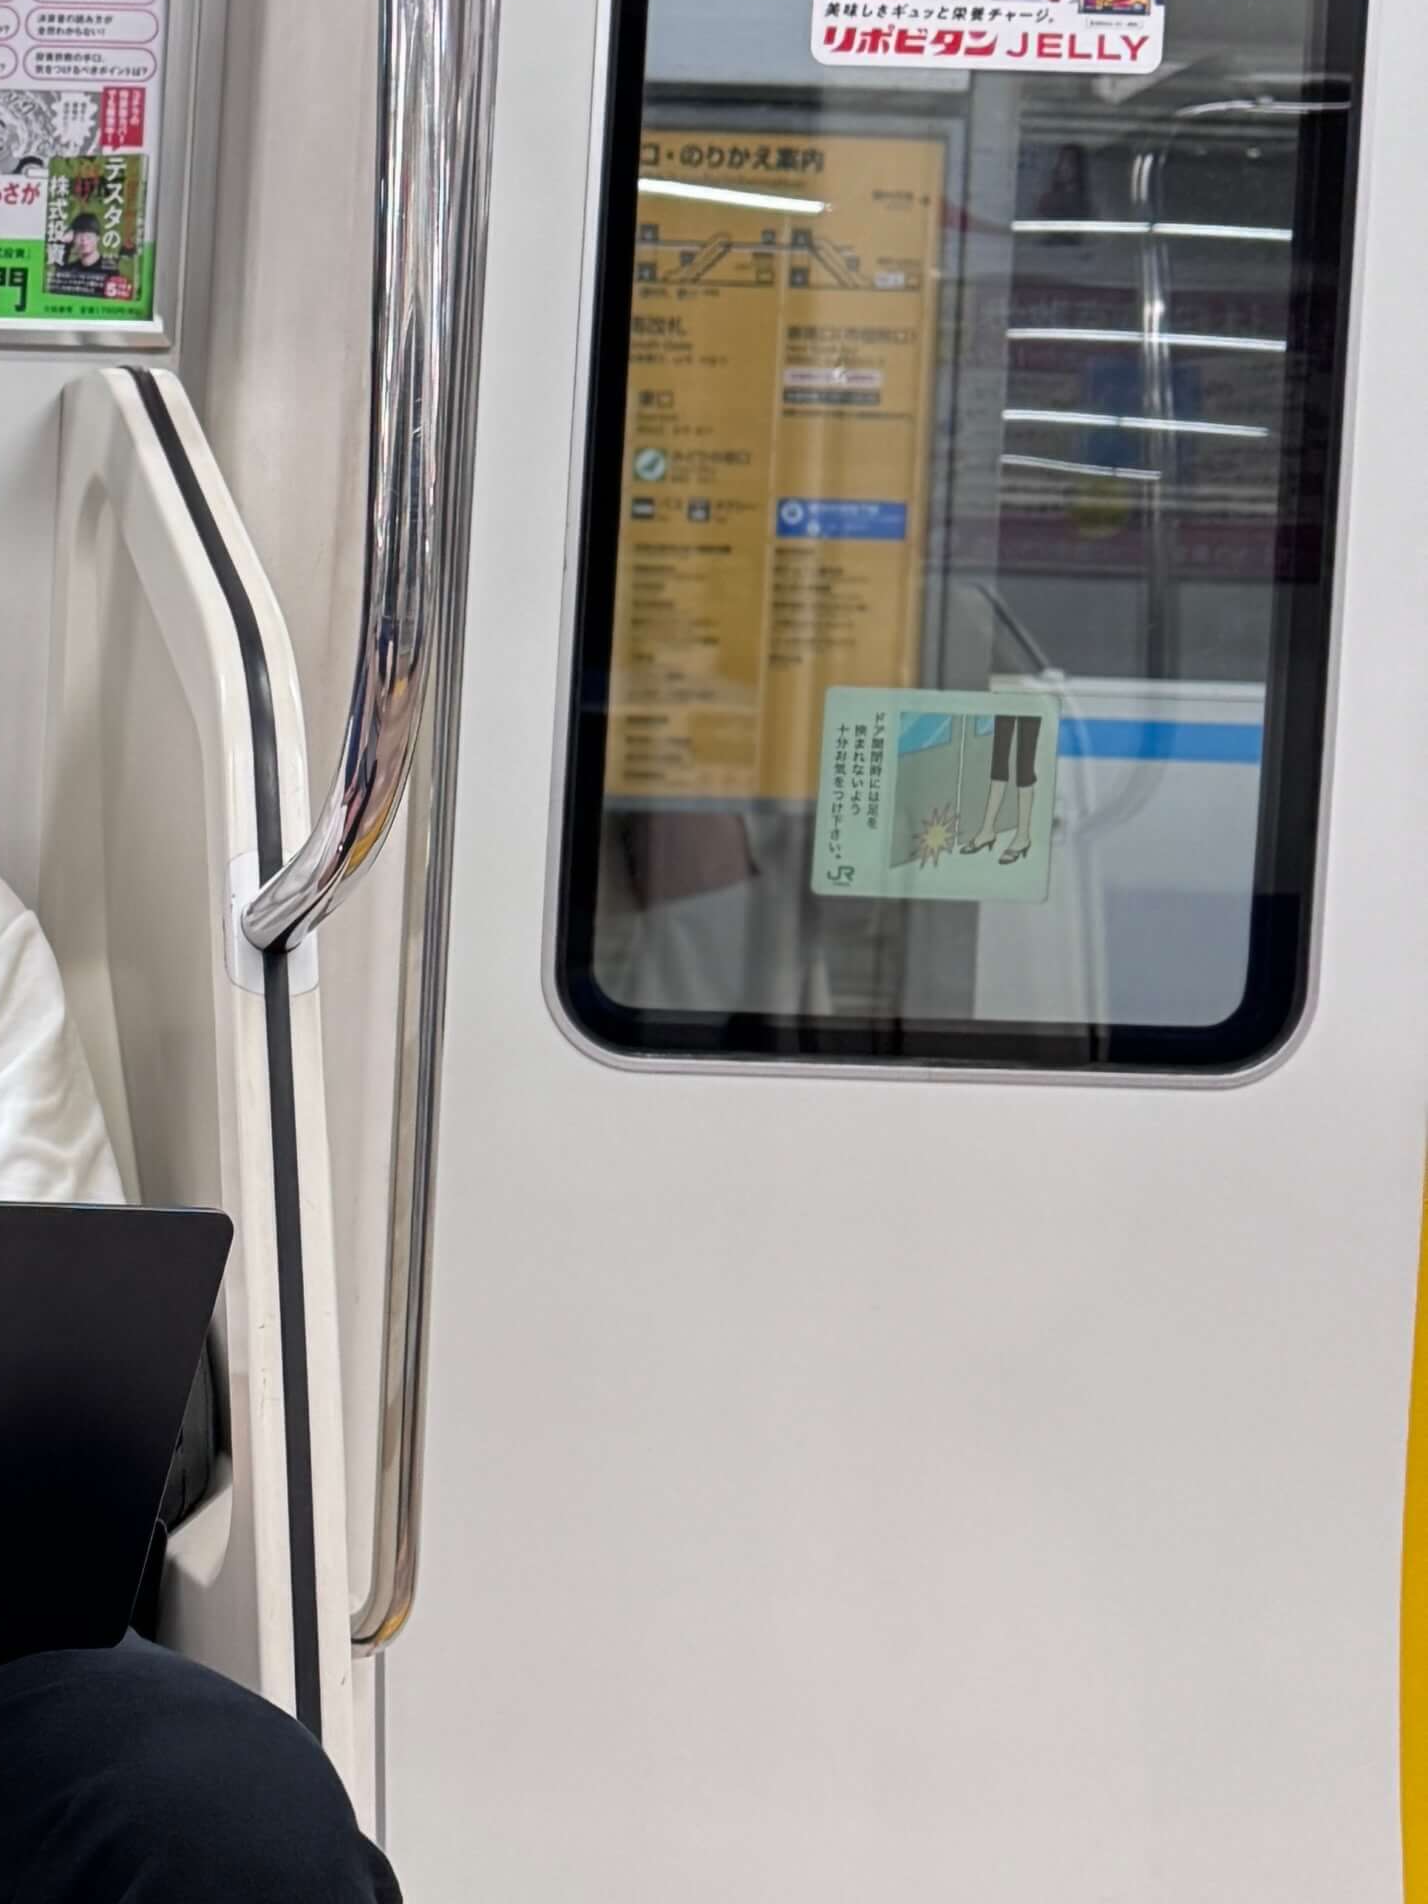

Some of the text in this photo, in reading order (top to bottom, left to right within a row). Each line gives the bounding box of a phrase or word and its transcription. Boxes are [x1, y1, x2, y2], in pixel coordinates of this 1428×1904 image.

[823, 23, 1150, 63] リポビタン JELLY
[827, 863, 856, 886] JR
